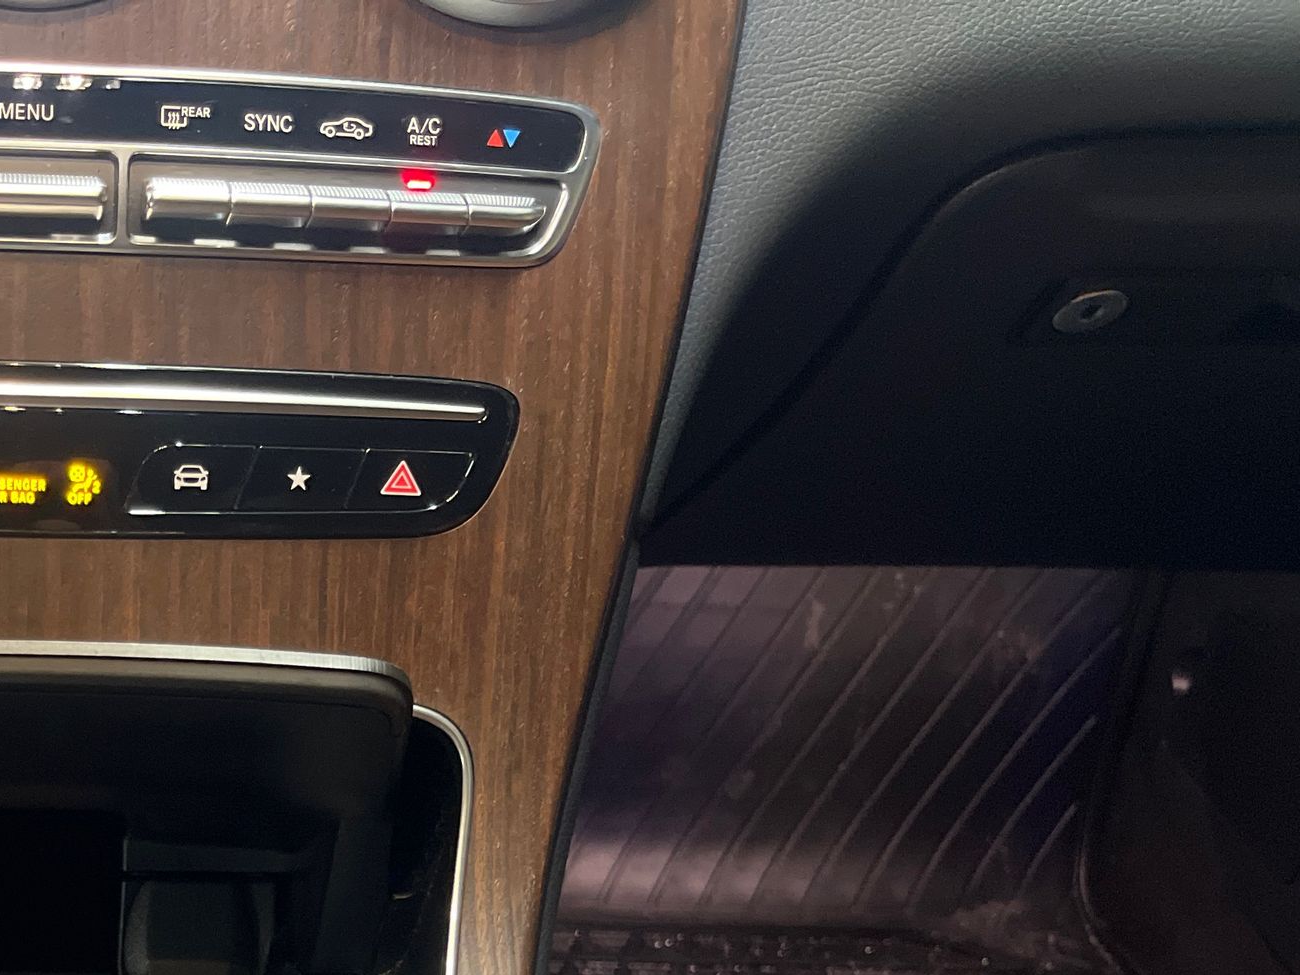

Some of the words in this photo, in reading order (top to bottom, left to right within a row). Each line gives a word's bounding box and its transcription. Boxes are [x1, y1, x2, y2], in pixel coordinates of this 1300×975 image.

[181, 105, 211, 120] REAR
[243, 112, 294, 134] SYNC
[406, 115, 441, 136] A/C
[409, 134, 438, 147] REST
[10, 491, 37, 505] BAG
[66, 492, 93, 506] OFF
